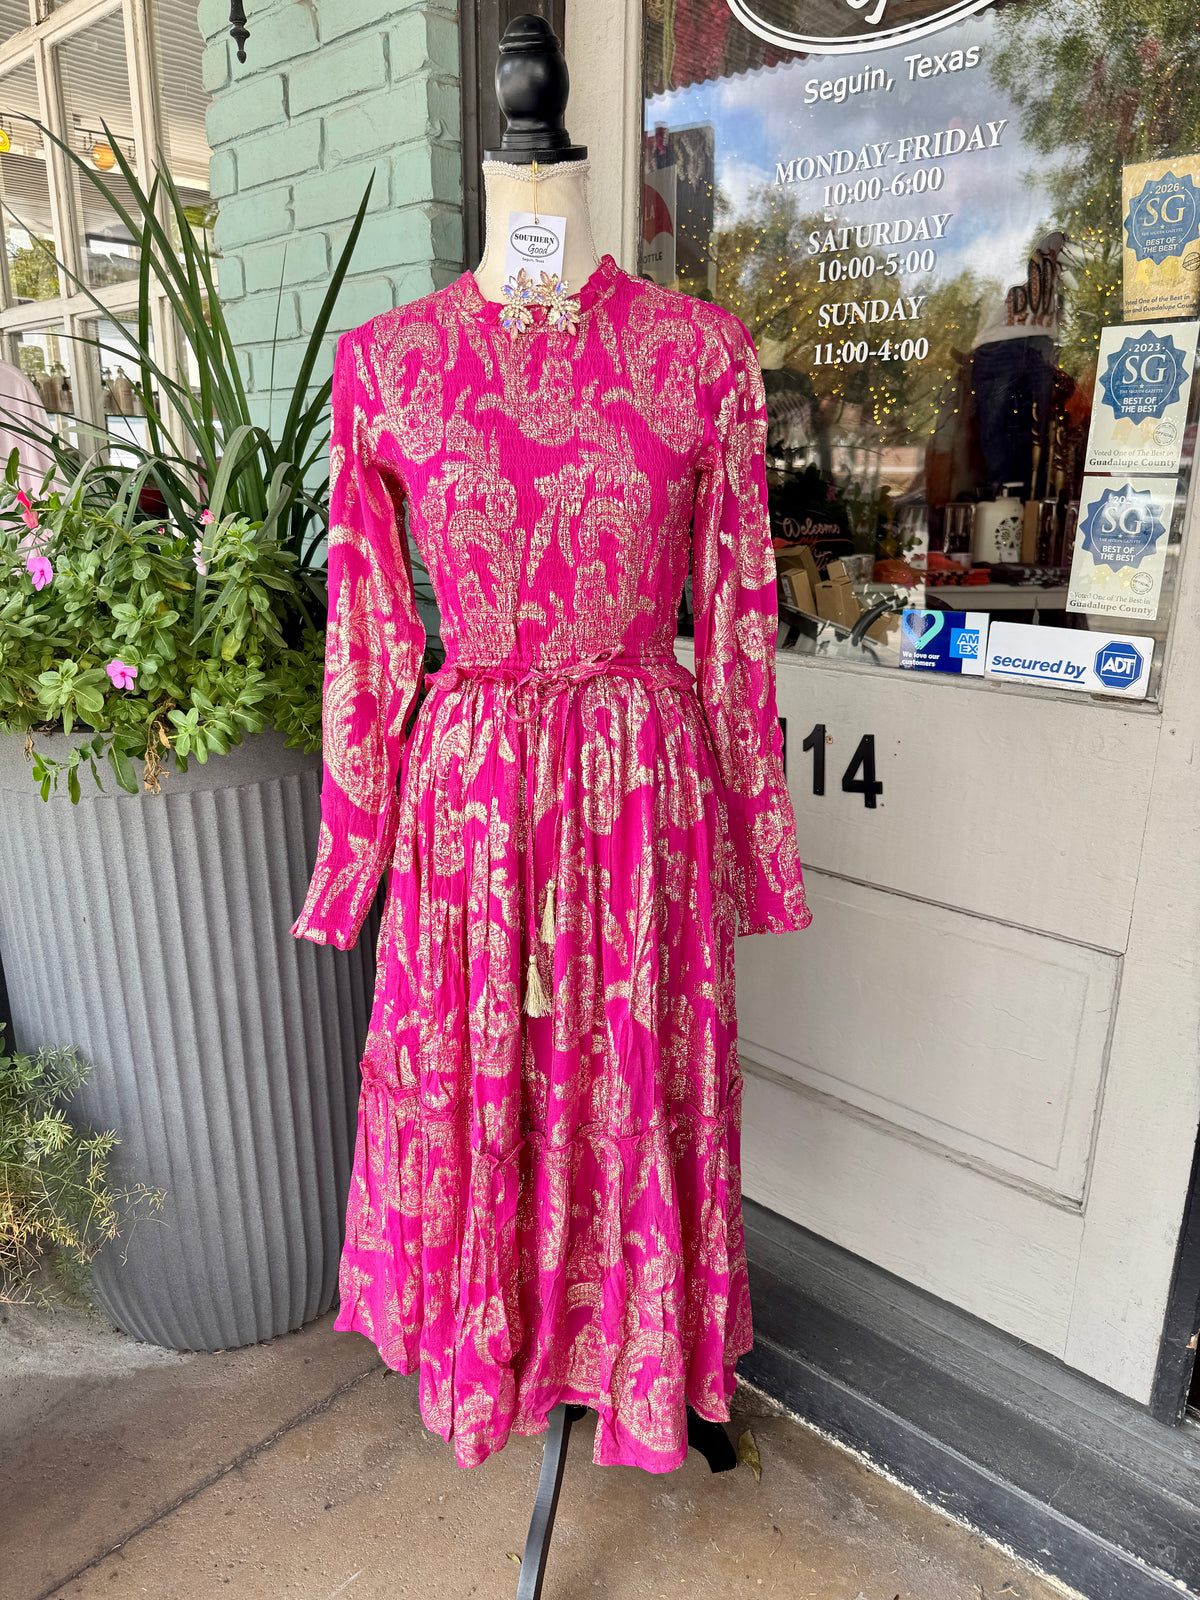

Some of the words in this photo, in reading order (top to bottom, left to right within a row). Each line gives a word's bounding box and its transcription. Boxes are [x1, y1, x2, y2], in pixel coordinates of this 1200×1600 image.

[804, 65, 894, 103] Seguin,
[904, 45, 981, 80] Texas
[774, 119, 1008, 186] MONDAY-FRIDAY
[823, 167, 943, 207] 10:00-6:00
[1155, 183, 1180, 194] 2026
[1143, 194, 1186, 226] SG
[514, 233, 555, 244] SOUTHERN
[807, 213, 953, 254] SATURDAY
[1145, 238, 1165, 246] BEST
[1166, 236, 1177, 244] OF
[528, 243, 551, 254] Good
[1143, 246, 1158, 254] THE
[1158, 244, 1178, 252] BEST
[817, 249, 935, 283] 10:00-5:00
[818, 296, 927, 327] SUNDAY
[1143, 304, 1175, 312] Guadalupe
[813, 338, 929, 365] 11:00-4:00
[1133, 343, 1160, 352] 2023
[1122, 354, 1167, 384] SG
[1123, 397, 1143, 405] BEST
[1145, 396, 1157, 404] OF
[1137, 405, 1158, 413] BEST
[1089, 458, 1139, 467] Guadalupe
[1141, 459, 1176, 468] County
[1101, 506, 1143, 534] SG
[1069, 600, 1117, 611] Guadalupe
[1119, 605, 1153, 616] County
[959, 634, 979, 644] AM
[913, 651, 927, 659] love
[959, 644, 978, 654] EX
[992, 655, 1063, 673] secured
[1064, 661, 1087, 679] by
[1102, 656, 1135, 675] ADT
